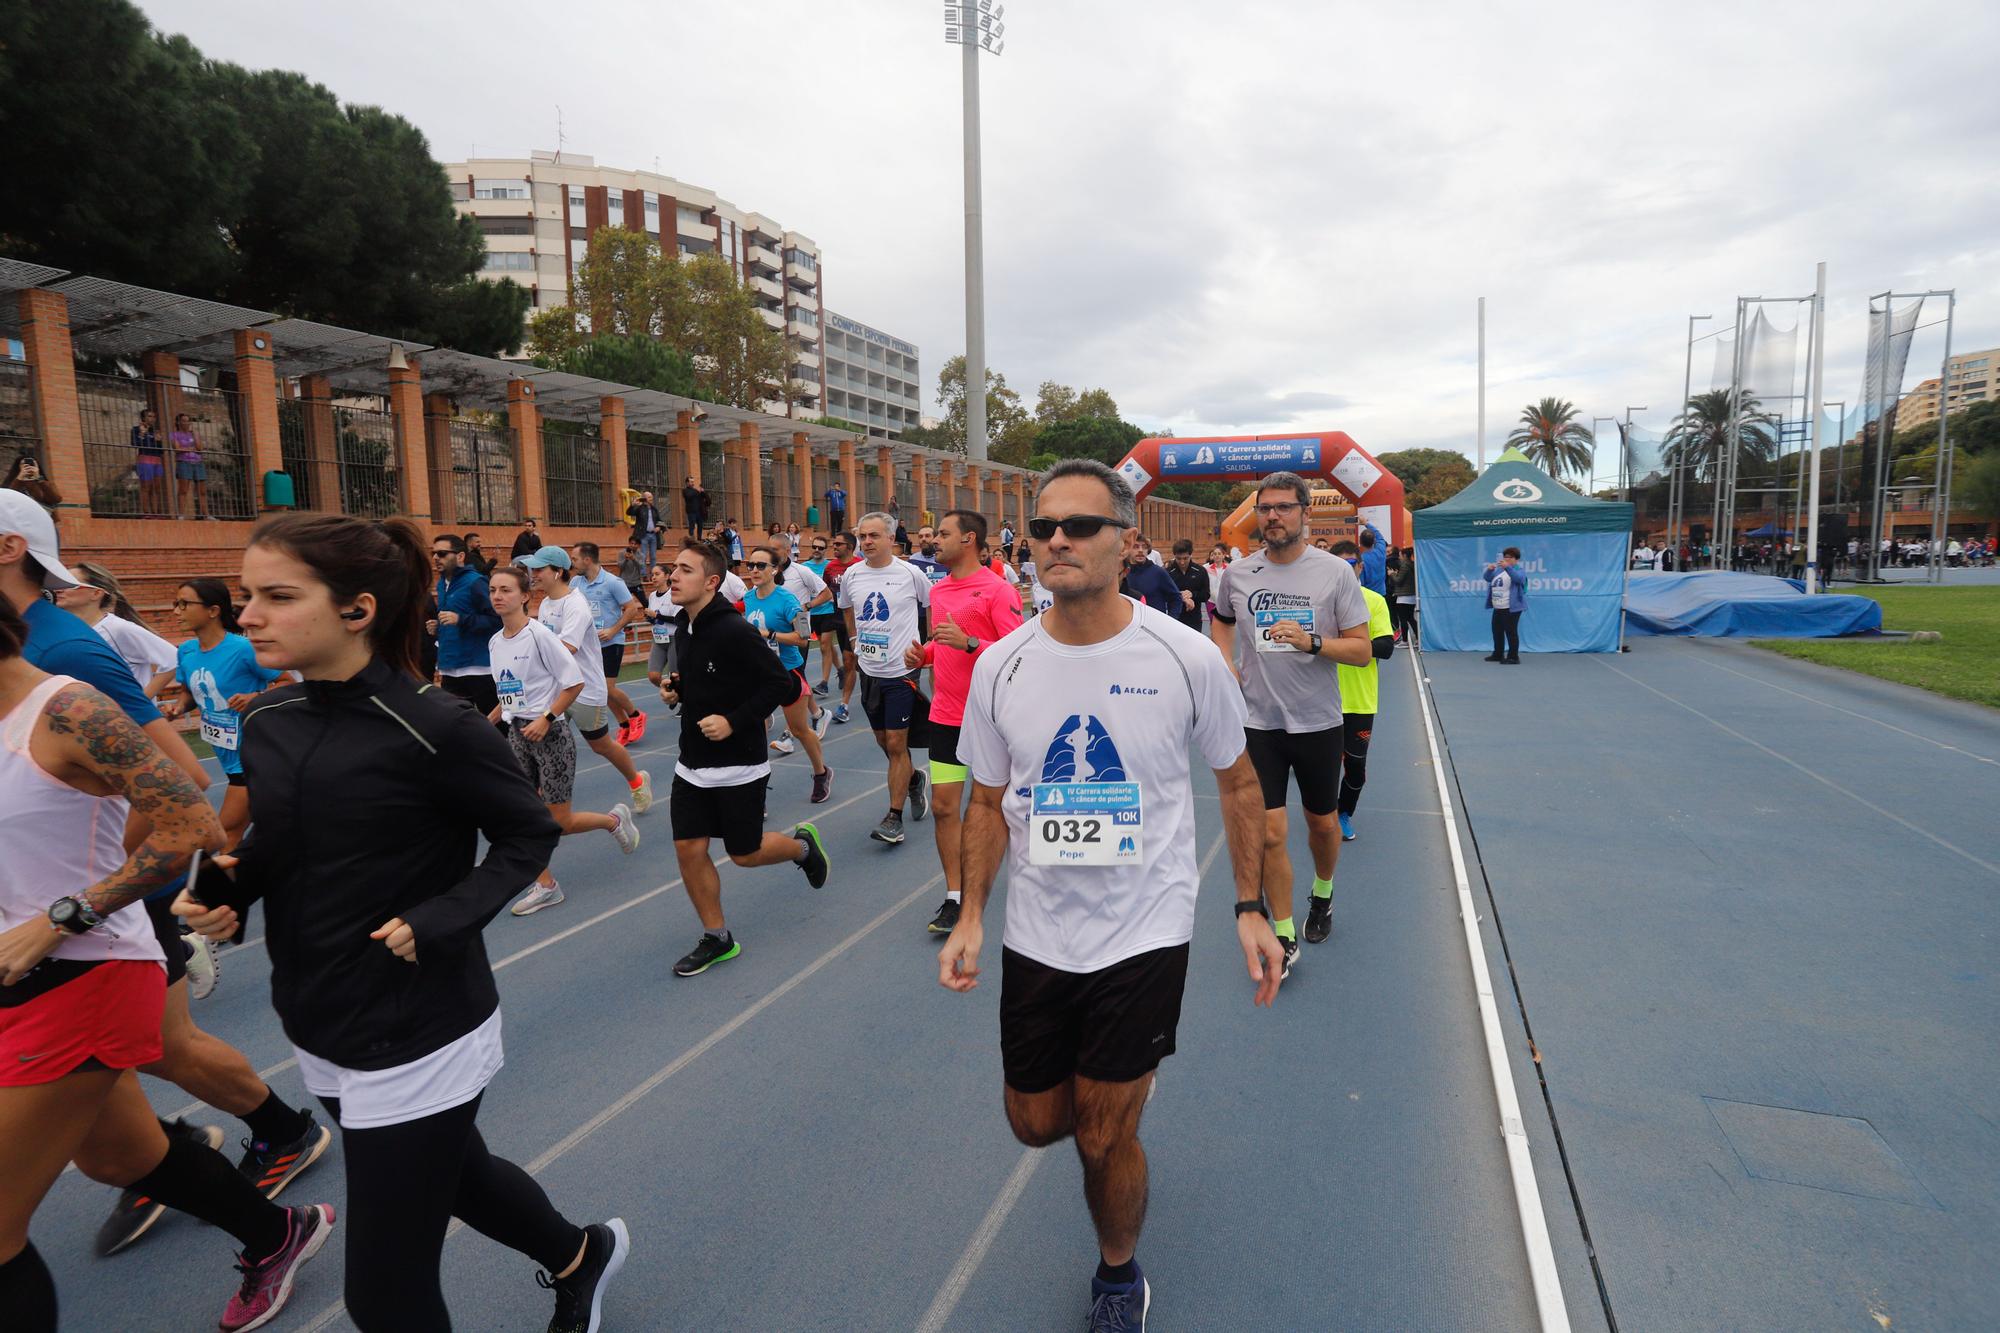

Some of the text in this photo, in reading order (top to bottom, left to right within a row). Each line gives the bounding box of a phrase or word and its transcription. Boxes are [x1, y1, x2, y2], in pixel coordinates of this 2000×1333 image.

[832, 315, 863, 336] COMPLEX
[1257, 444, 1291, 452] solidaria
[1263, 452, 1291, 461] pulmón
[1225, 464, 1252, 472] SALIDA
[1473, 516, 1567, 526] www.cronorunner.com
[1311, 527, 1332, 536] ESTADI
[1334, 527, 1345, 535] DEL
[1279, 593, 1310, 601] Nocturna
[1278, 599, 1310, 607] VALENCIA
[203, 724, 220, 738] 132
[1075, 787, 1101, 795] Carrera
[1101, 786, 1132, 795] solidaria
[1075, 795, 1097, 803] cáncer
[1107, 795, 1133, 804] pulmón
[1116, 811, 1137, 822] 10K
[1042, 819, 1101, 843] 032
[1059, 850, 1085, 860] Pepe
